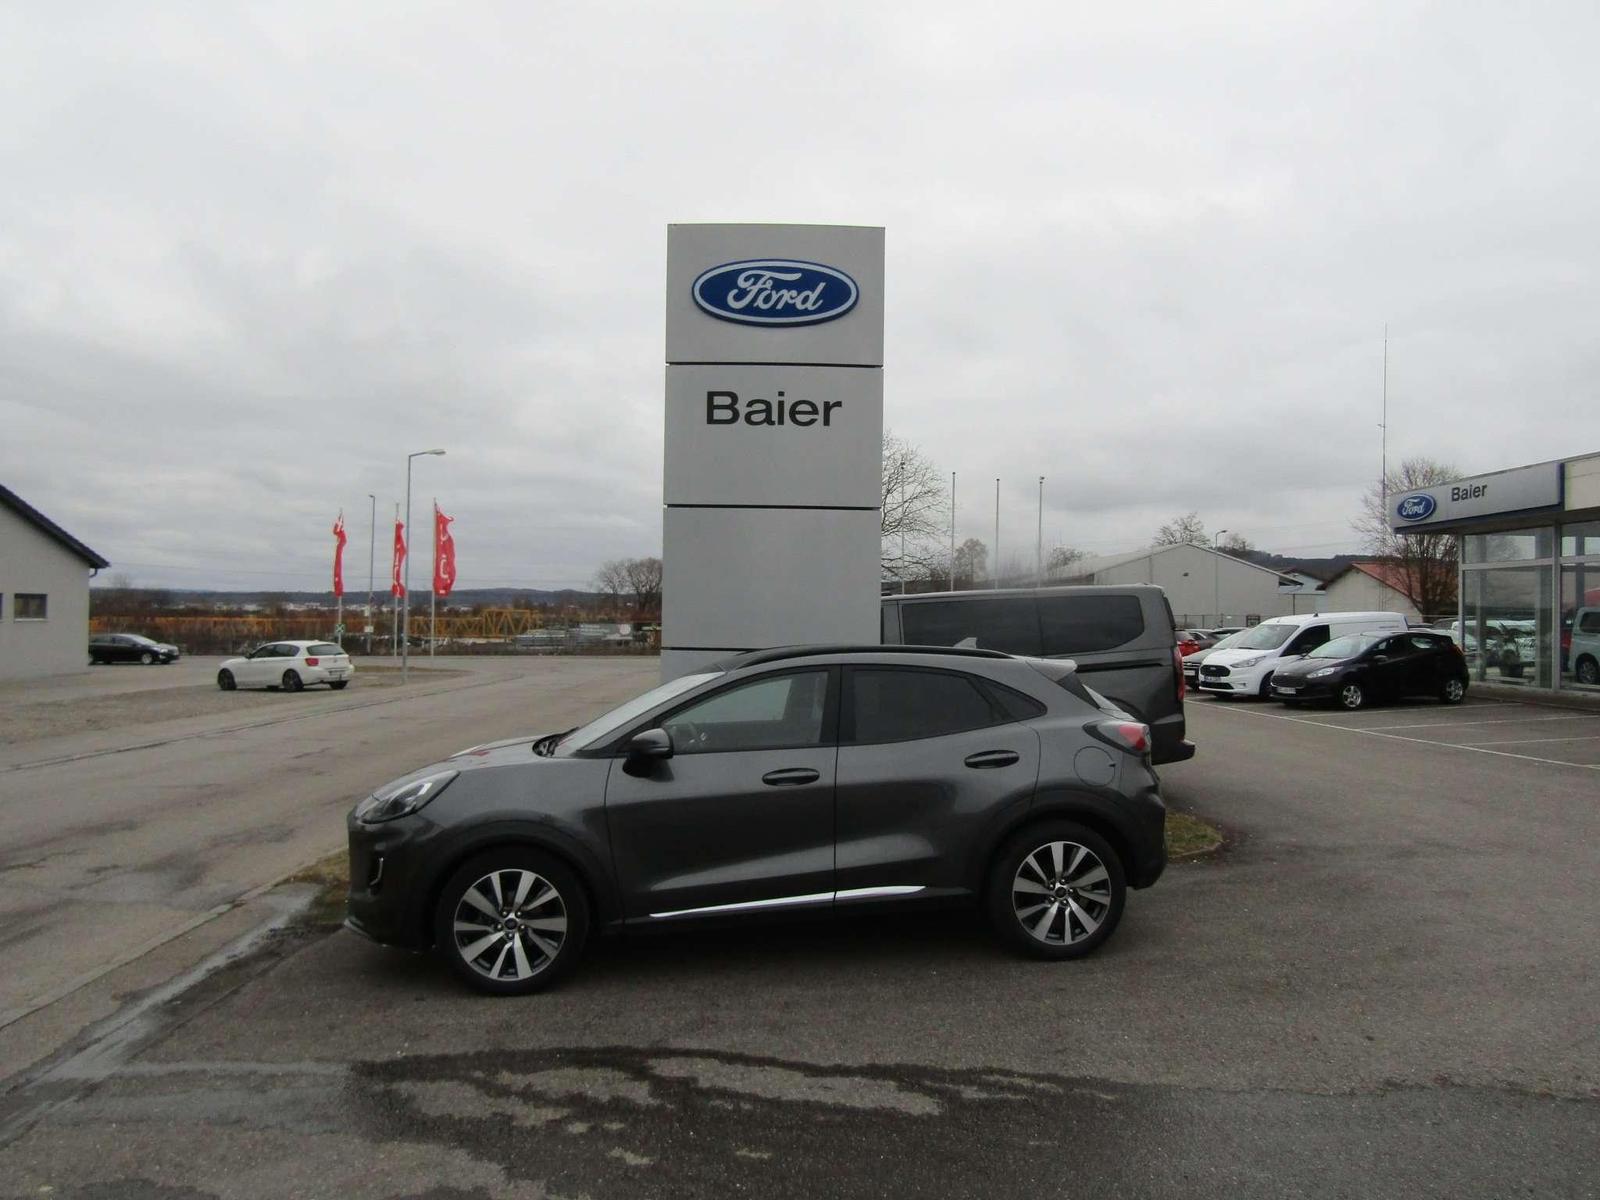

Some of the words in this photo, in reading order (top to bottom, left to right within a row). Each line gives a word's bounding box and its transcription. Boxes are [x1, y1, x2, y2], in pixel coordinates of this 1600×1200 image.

[726, 269, 827, 311] Ford
[706, 390, 843, 427] Baier
[1451, 483, 1488, 502] Baier
[1401, 498, 1425, 517] Ford
